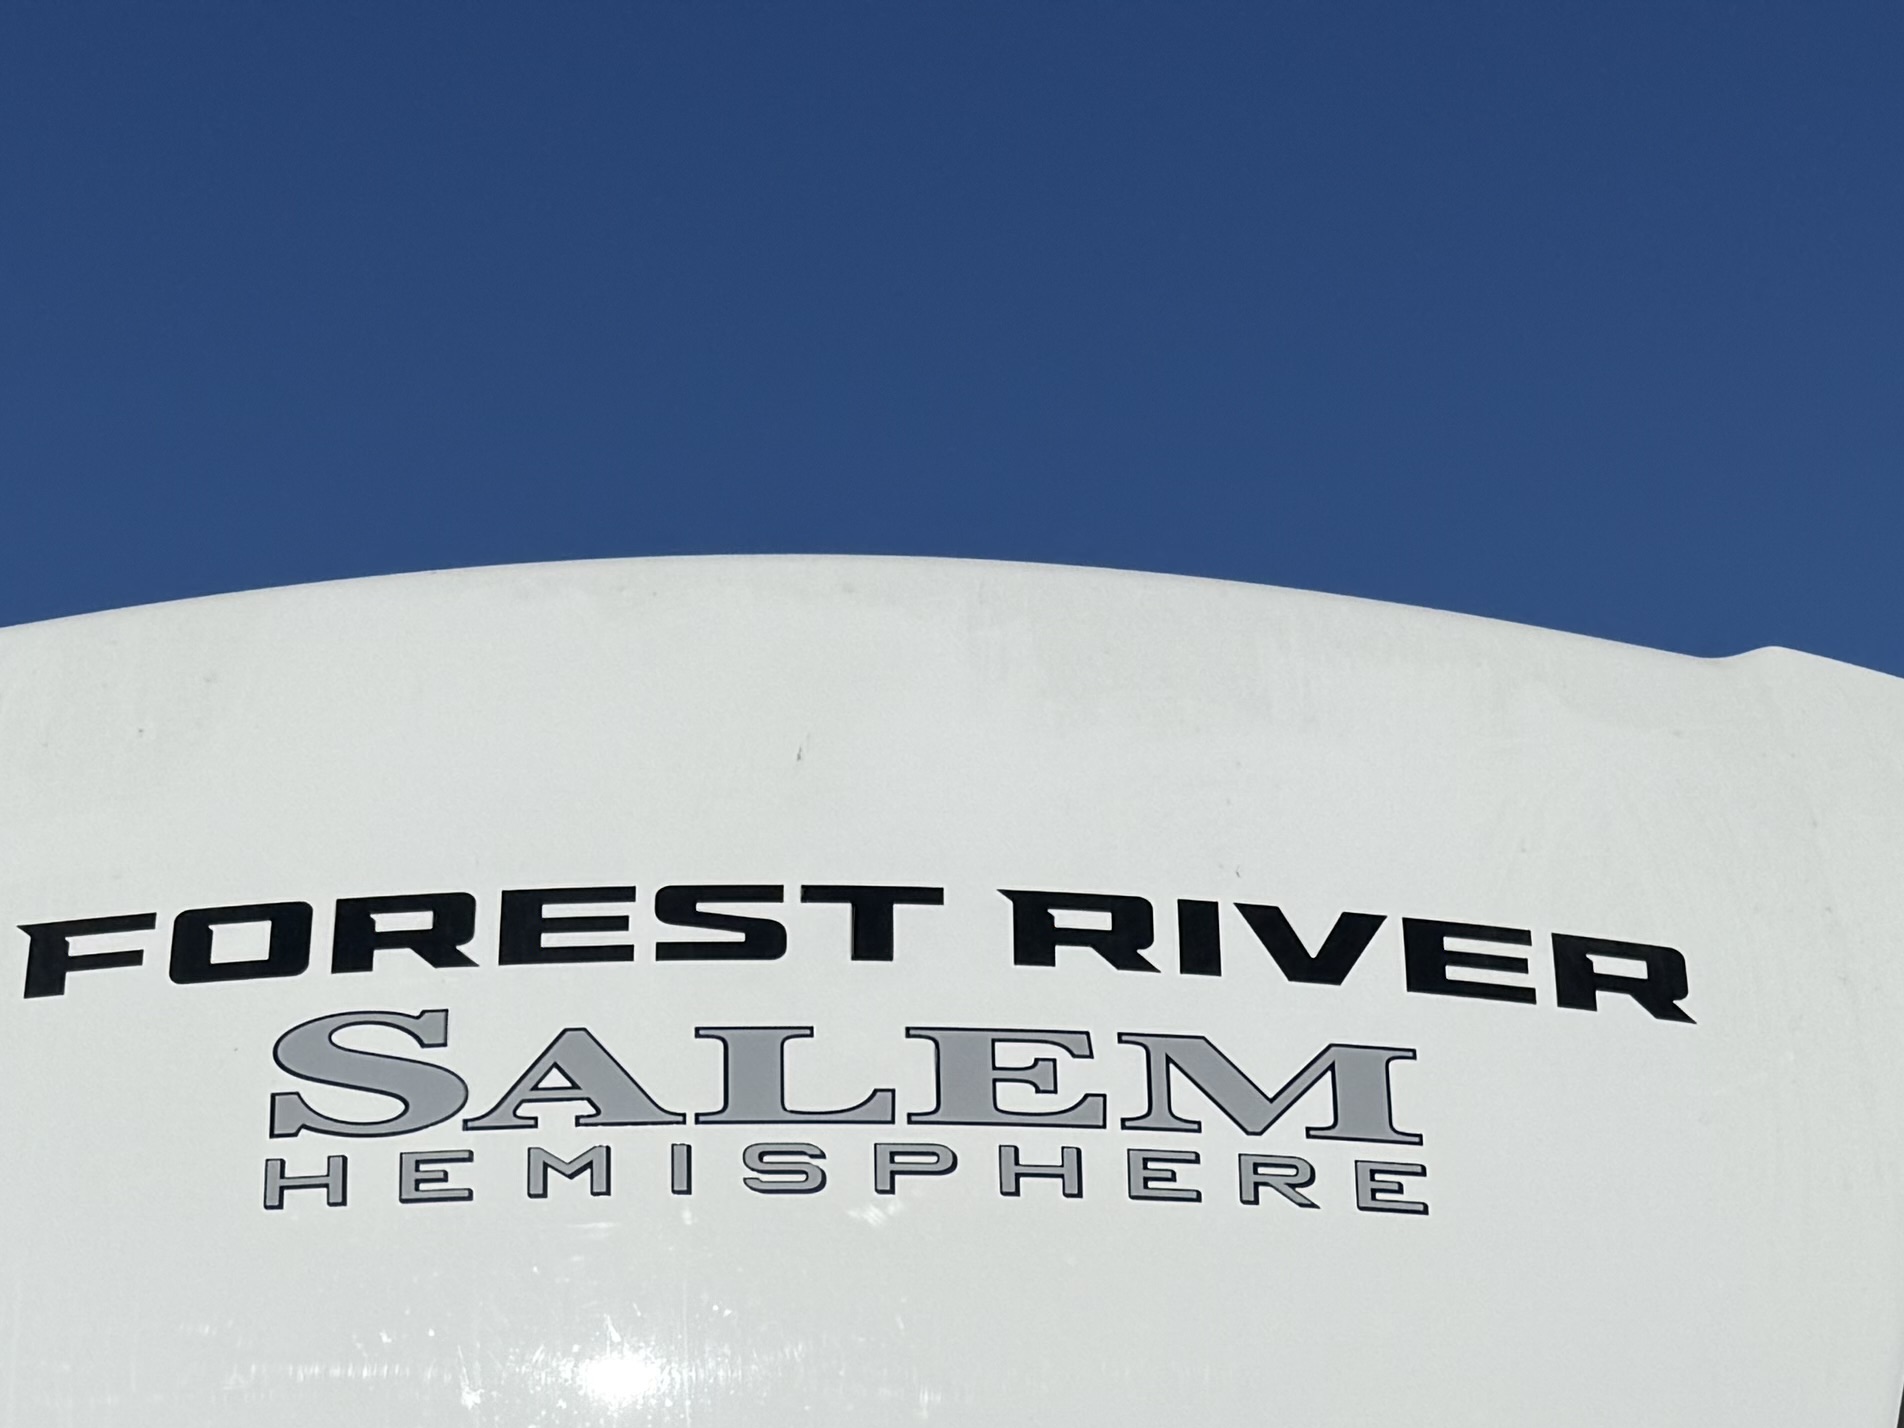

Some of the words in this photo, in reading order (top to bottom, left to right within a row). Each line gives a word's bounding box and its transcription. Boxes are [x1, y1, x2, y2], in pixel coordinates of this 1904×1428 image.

[16, 884, 945, 999] FOREST
[996, 888, 1698, 1025] RIVER
[268, 1008, 1425, 1146] SALEM
[262, 1141, 1431, 1216] HEMISPHERE
